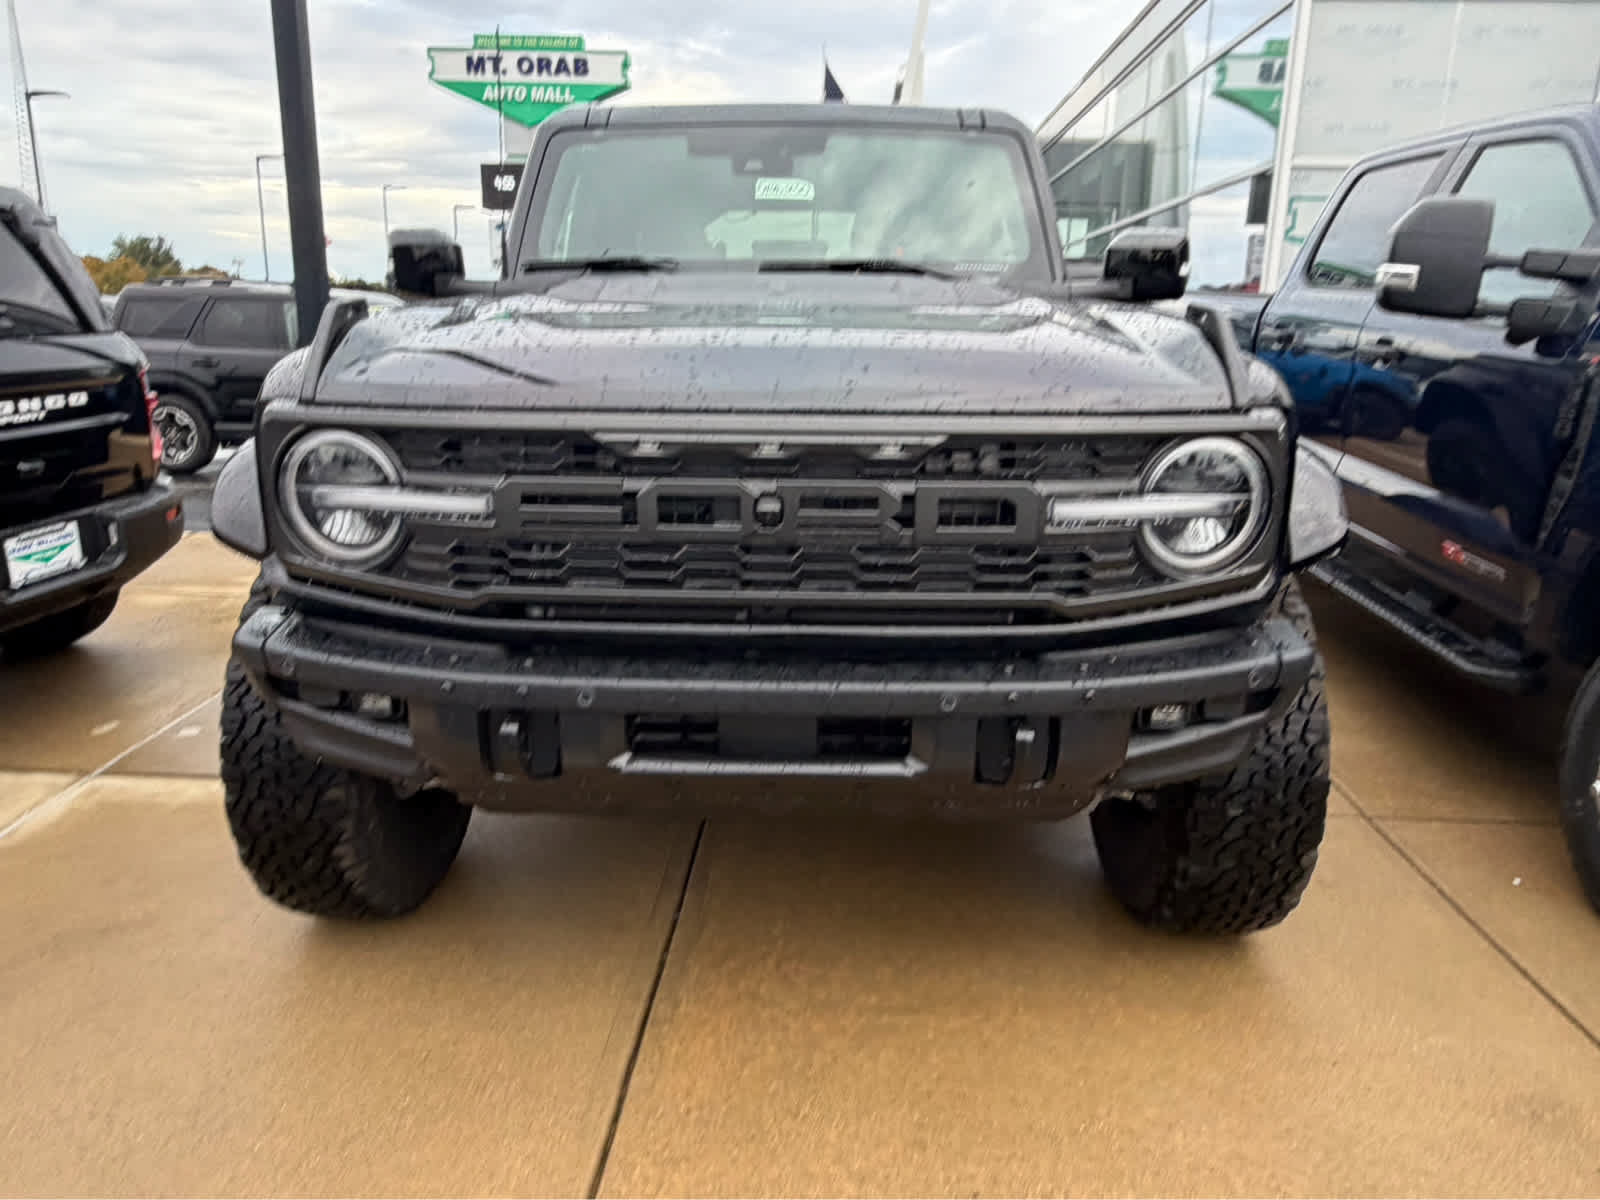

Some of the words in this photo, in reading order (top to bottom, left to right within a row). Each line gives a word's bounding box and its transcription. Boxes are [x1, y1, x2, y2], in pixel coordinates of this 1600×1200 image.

[466, 55, 507, 76] MT.
[516, 56, 590, 77] ORAB
[482, 84, 526, 103] AUTO
[493, 478, 1047, 544] FORD
